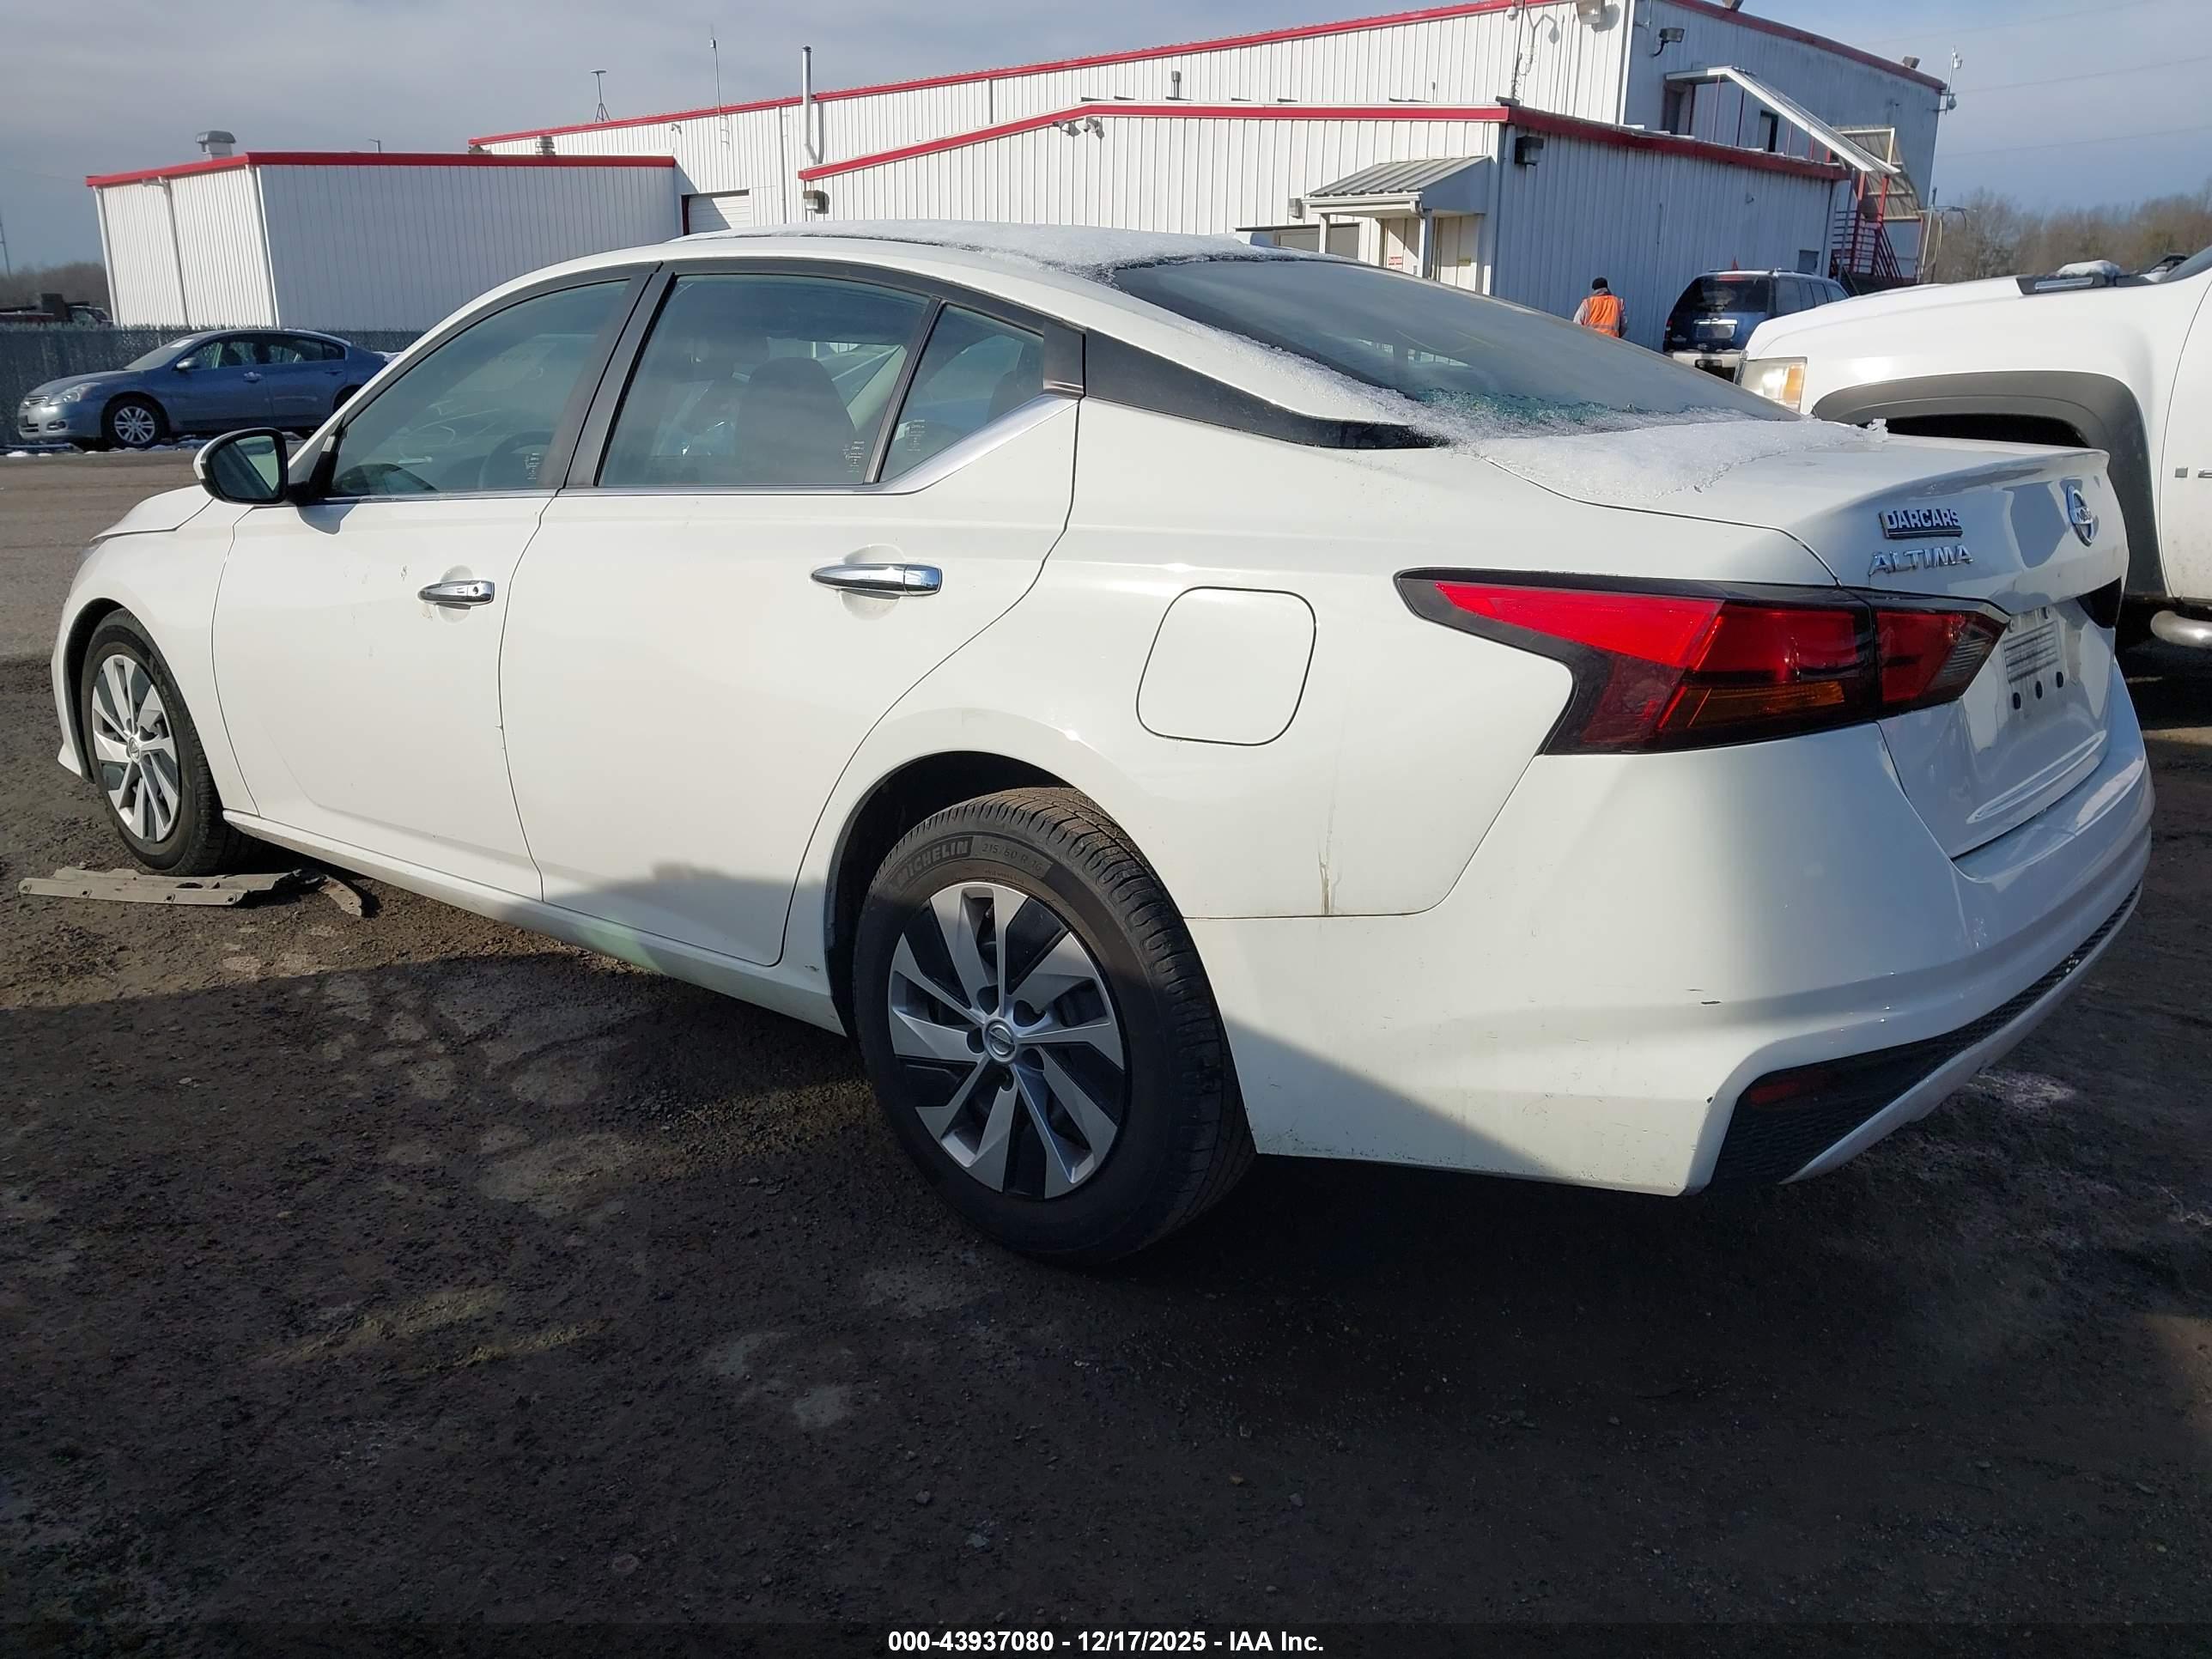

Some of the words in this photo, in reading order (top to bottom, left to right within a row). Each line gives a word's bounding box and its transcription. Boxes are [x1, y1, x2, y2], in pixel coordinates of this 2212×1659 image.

[1886, 508, 1961, 530] DARCARS
[1869, 544, 1973, 574] ALTIMA
[896, 840, 969, 888] MICHELIN
